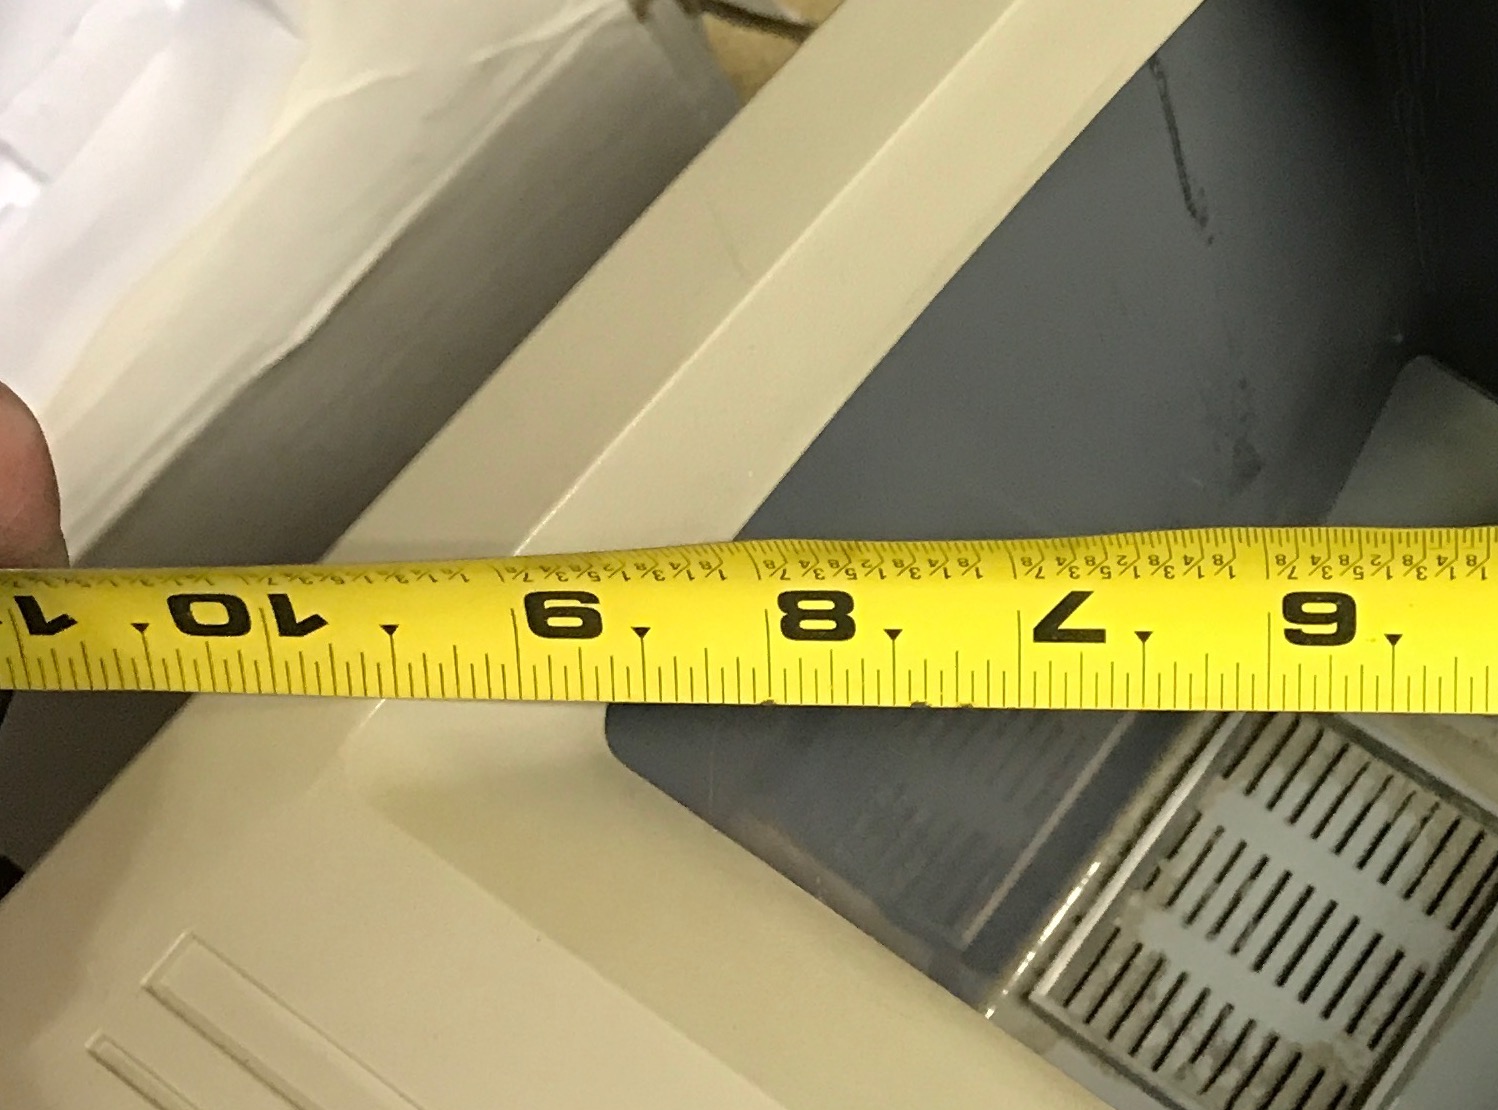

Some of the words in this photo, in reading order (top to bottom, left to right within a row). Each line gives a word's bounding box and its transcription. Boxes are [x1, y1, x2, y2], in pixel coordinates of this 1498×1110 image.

[166, 594, 328, 638] 10
[524, 590, 602, 640] 9
[778, 590, 856, 642] 8
[1034, 592, 1106, 642] 7
[1282, 592, 1356, 646] 6
